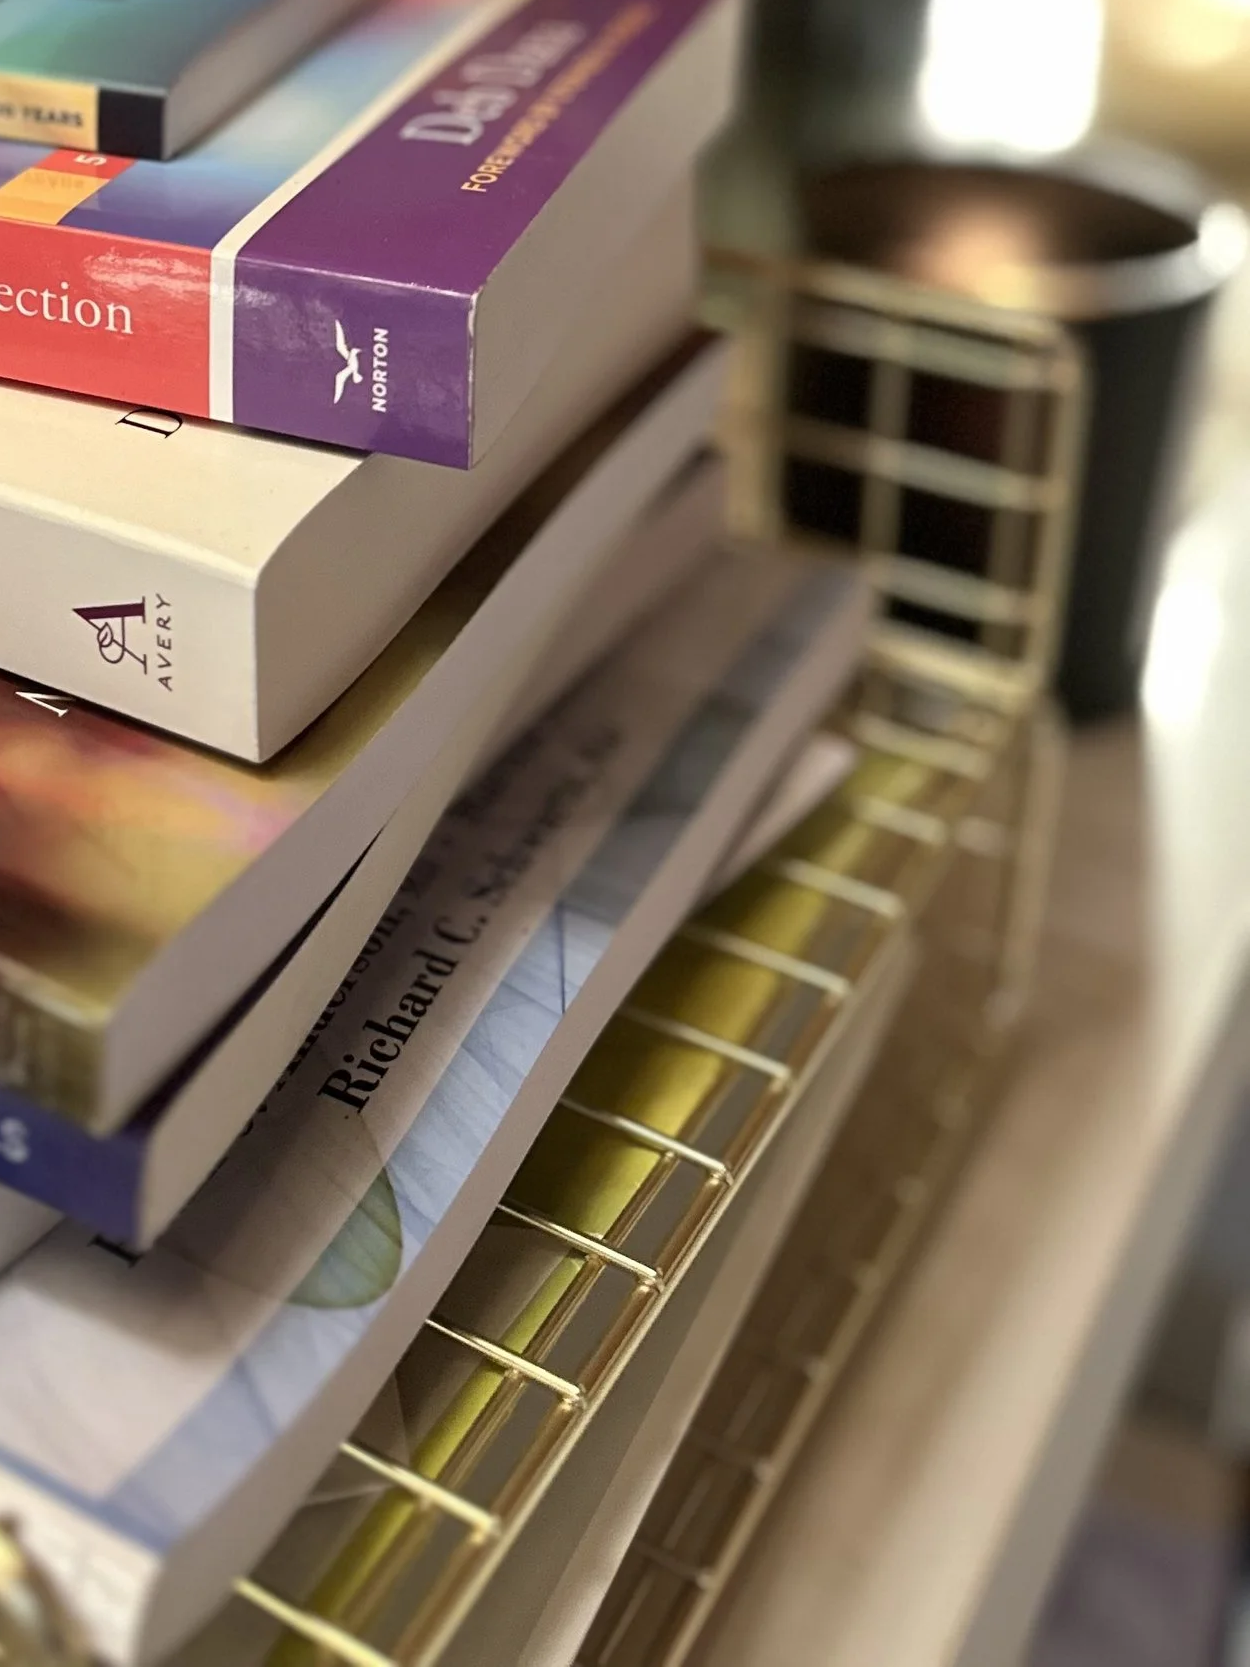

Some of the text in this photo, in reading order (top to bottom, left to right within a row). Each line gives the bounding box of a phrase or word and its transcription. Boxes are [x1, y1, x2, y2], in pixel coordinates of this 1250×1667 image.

[21, 101, 84, 127] YEARS
[372, 327, 390, 413] NORTON
[155, 593, 172, 692] AVERY
[316, 946, 459, 1114] Richard
